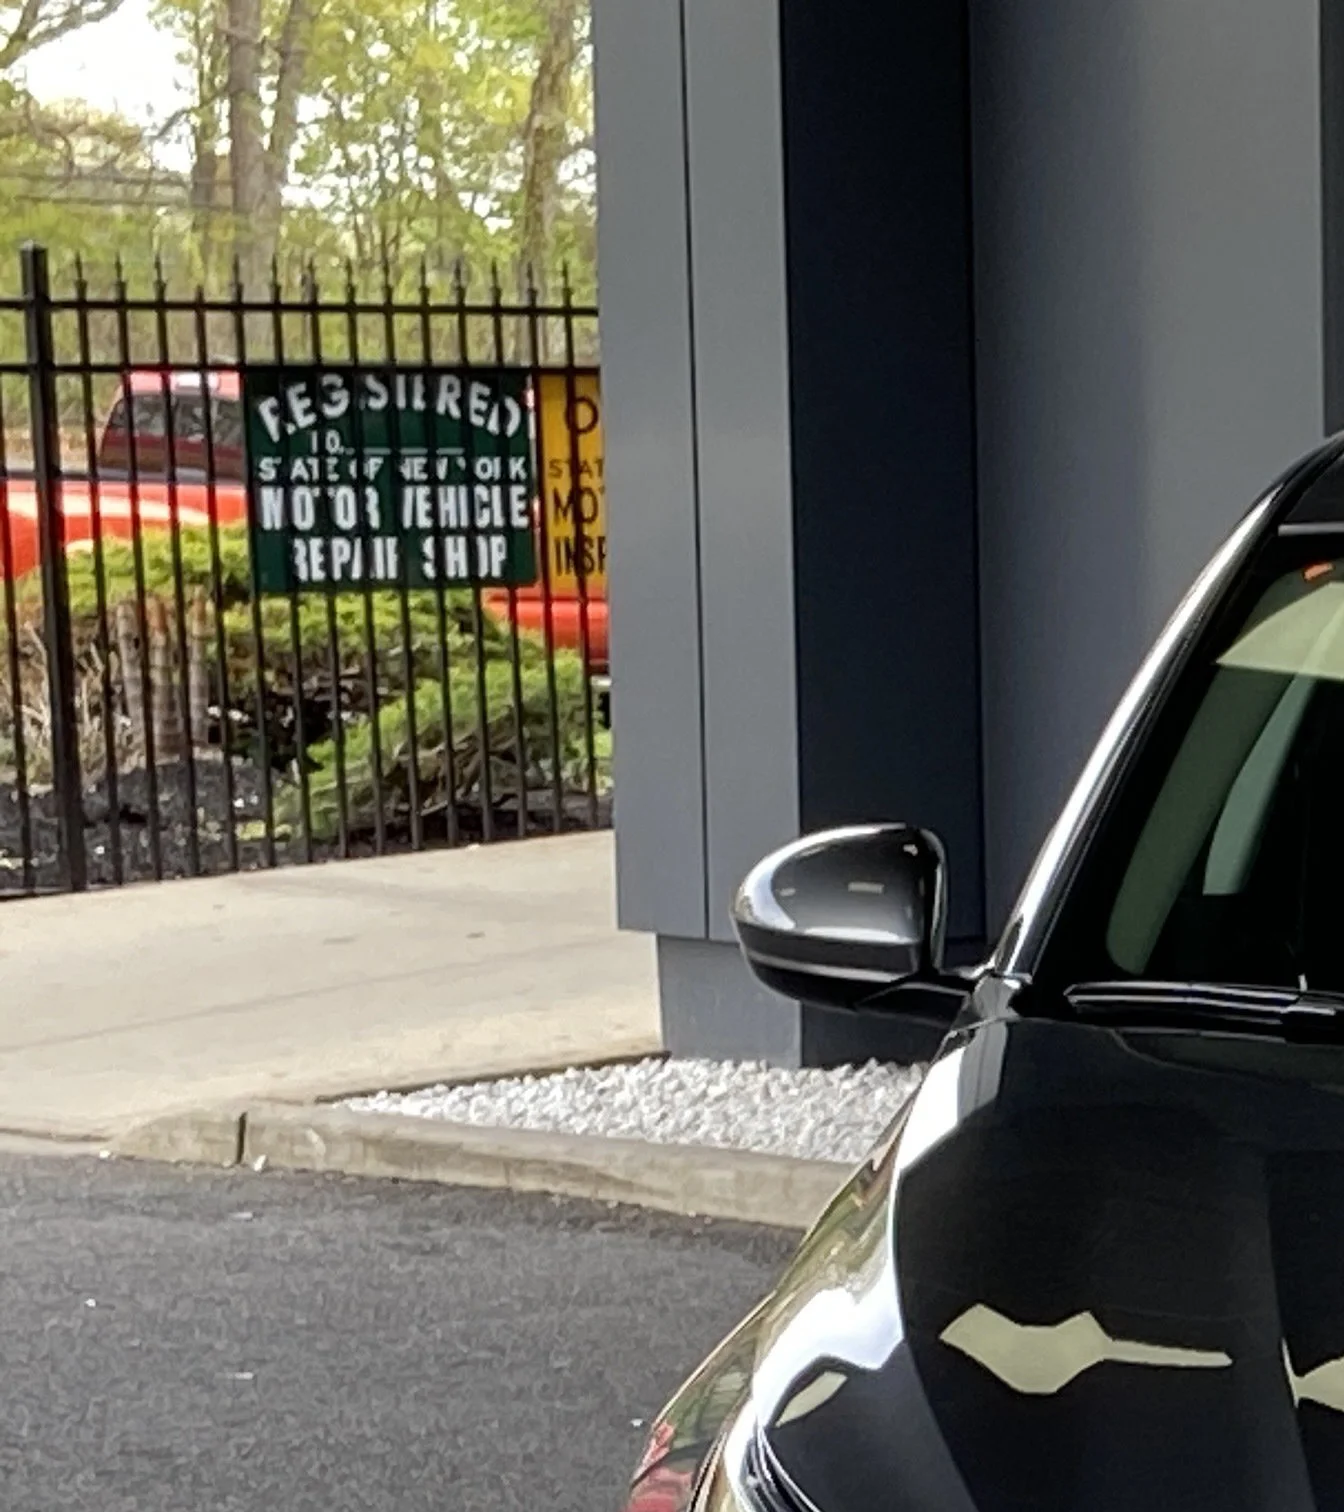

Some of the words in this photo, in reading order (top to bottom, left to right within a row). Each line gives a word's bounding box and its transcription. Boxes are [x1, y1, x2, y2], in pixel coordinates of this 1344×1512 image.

[257, 372, 521, 442] REGSTERED
[259, 456, 341, 481] SATE
[260, 484, 381, 531] MOOR
[552, 486, 605, 524] MO
